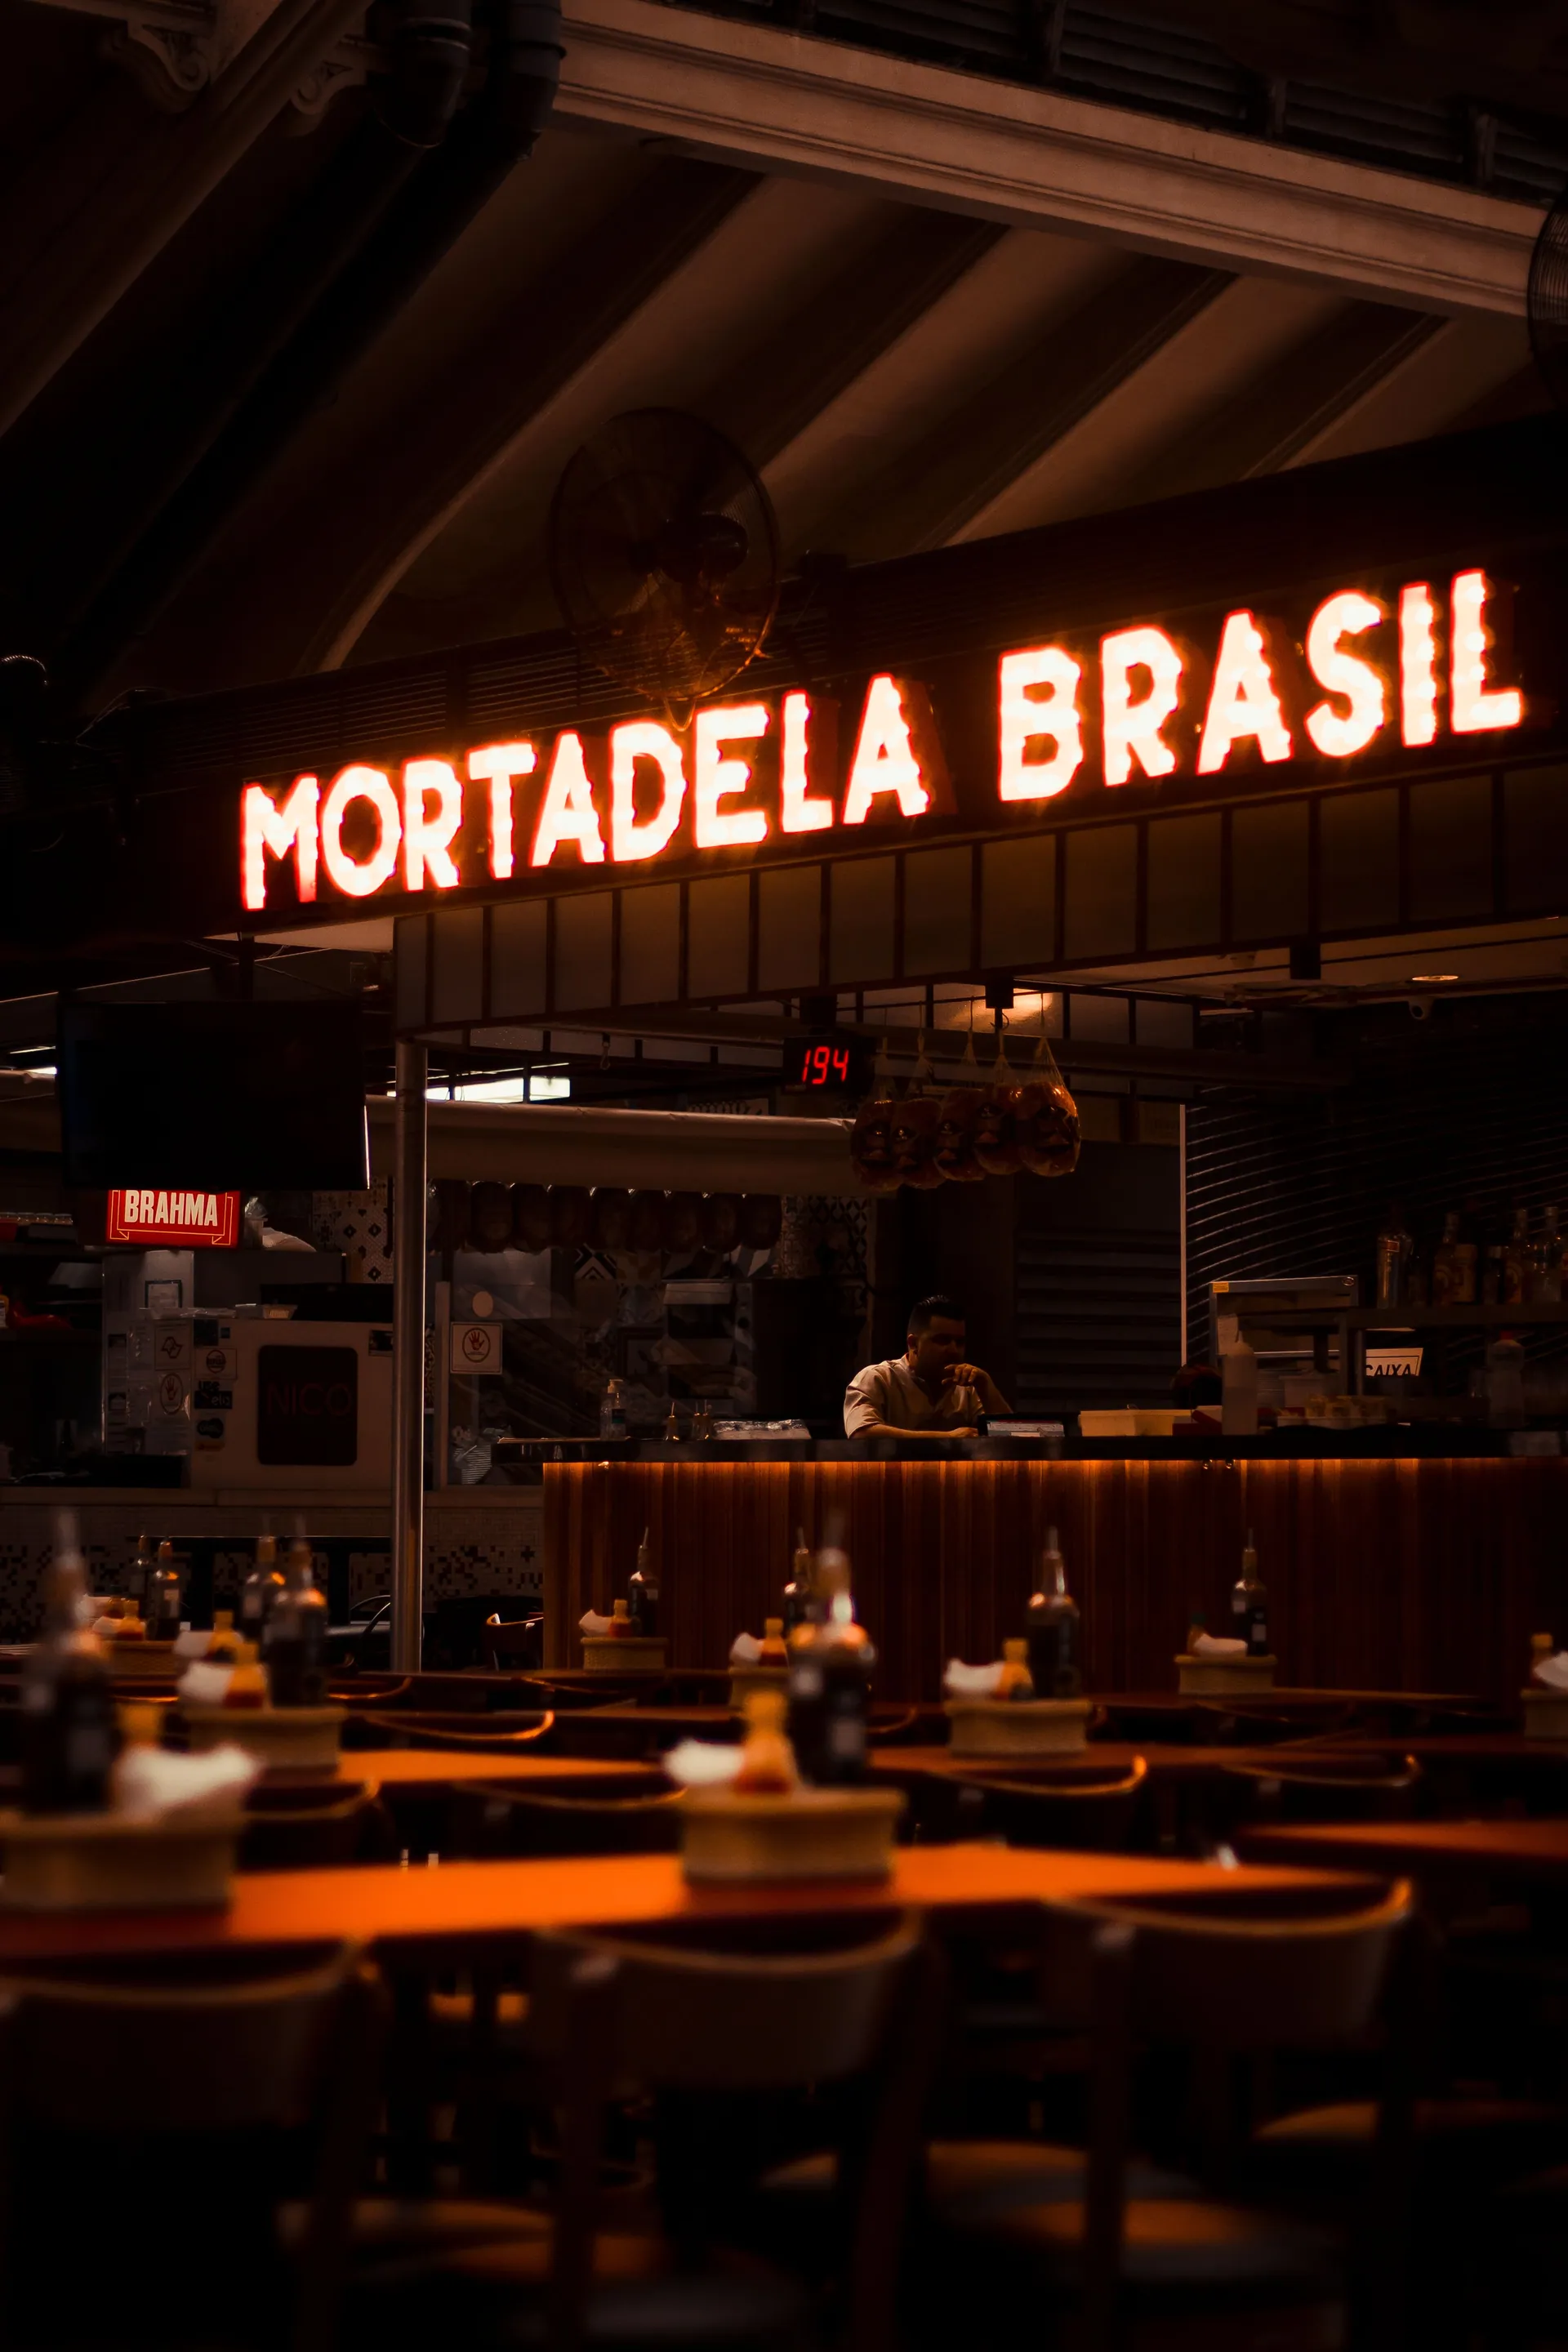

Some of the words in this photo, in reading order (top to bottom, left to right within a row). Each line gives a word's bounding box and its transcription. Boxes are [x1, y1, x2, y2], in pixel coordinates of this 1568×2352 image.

[240, 673, 929, 911] MORTADELA
[996, 568, 1526, 804] BRASIL
[802, 1046, 849, 1085] 194
[123, 1189, 218, 1227] BRAHMA
